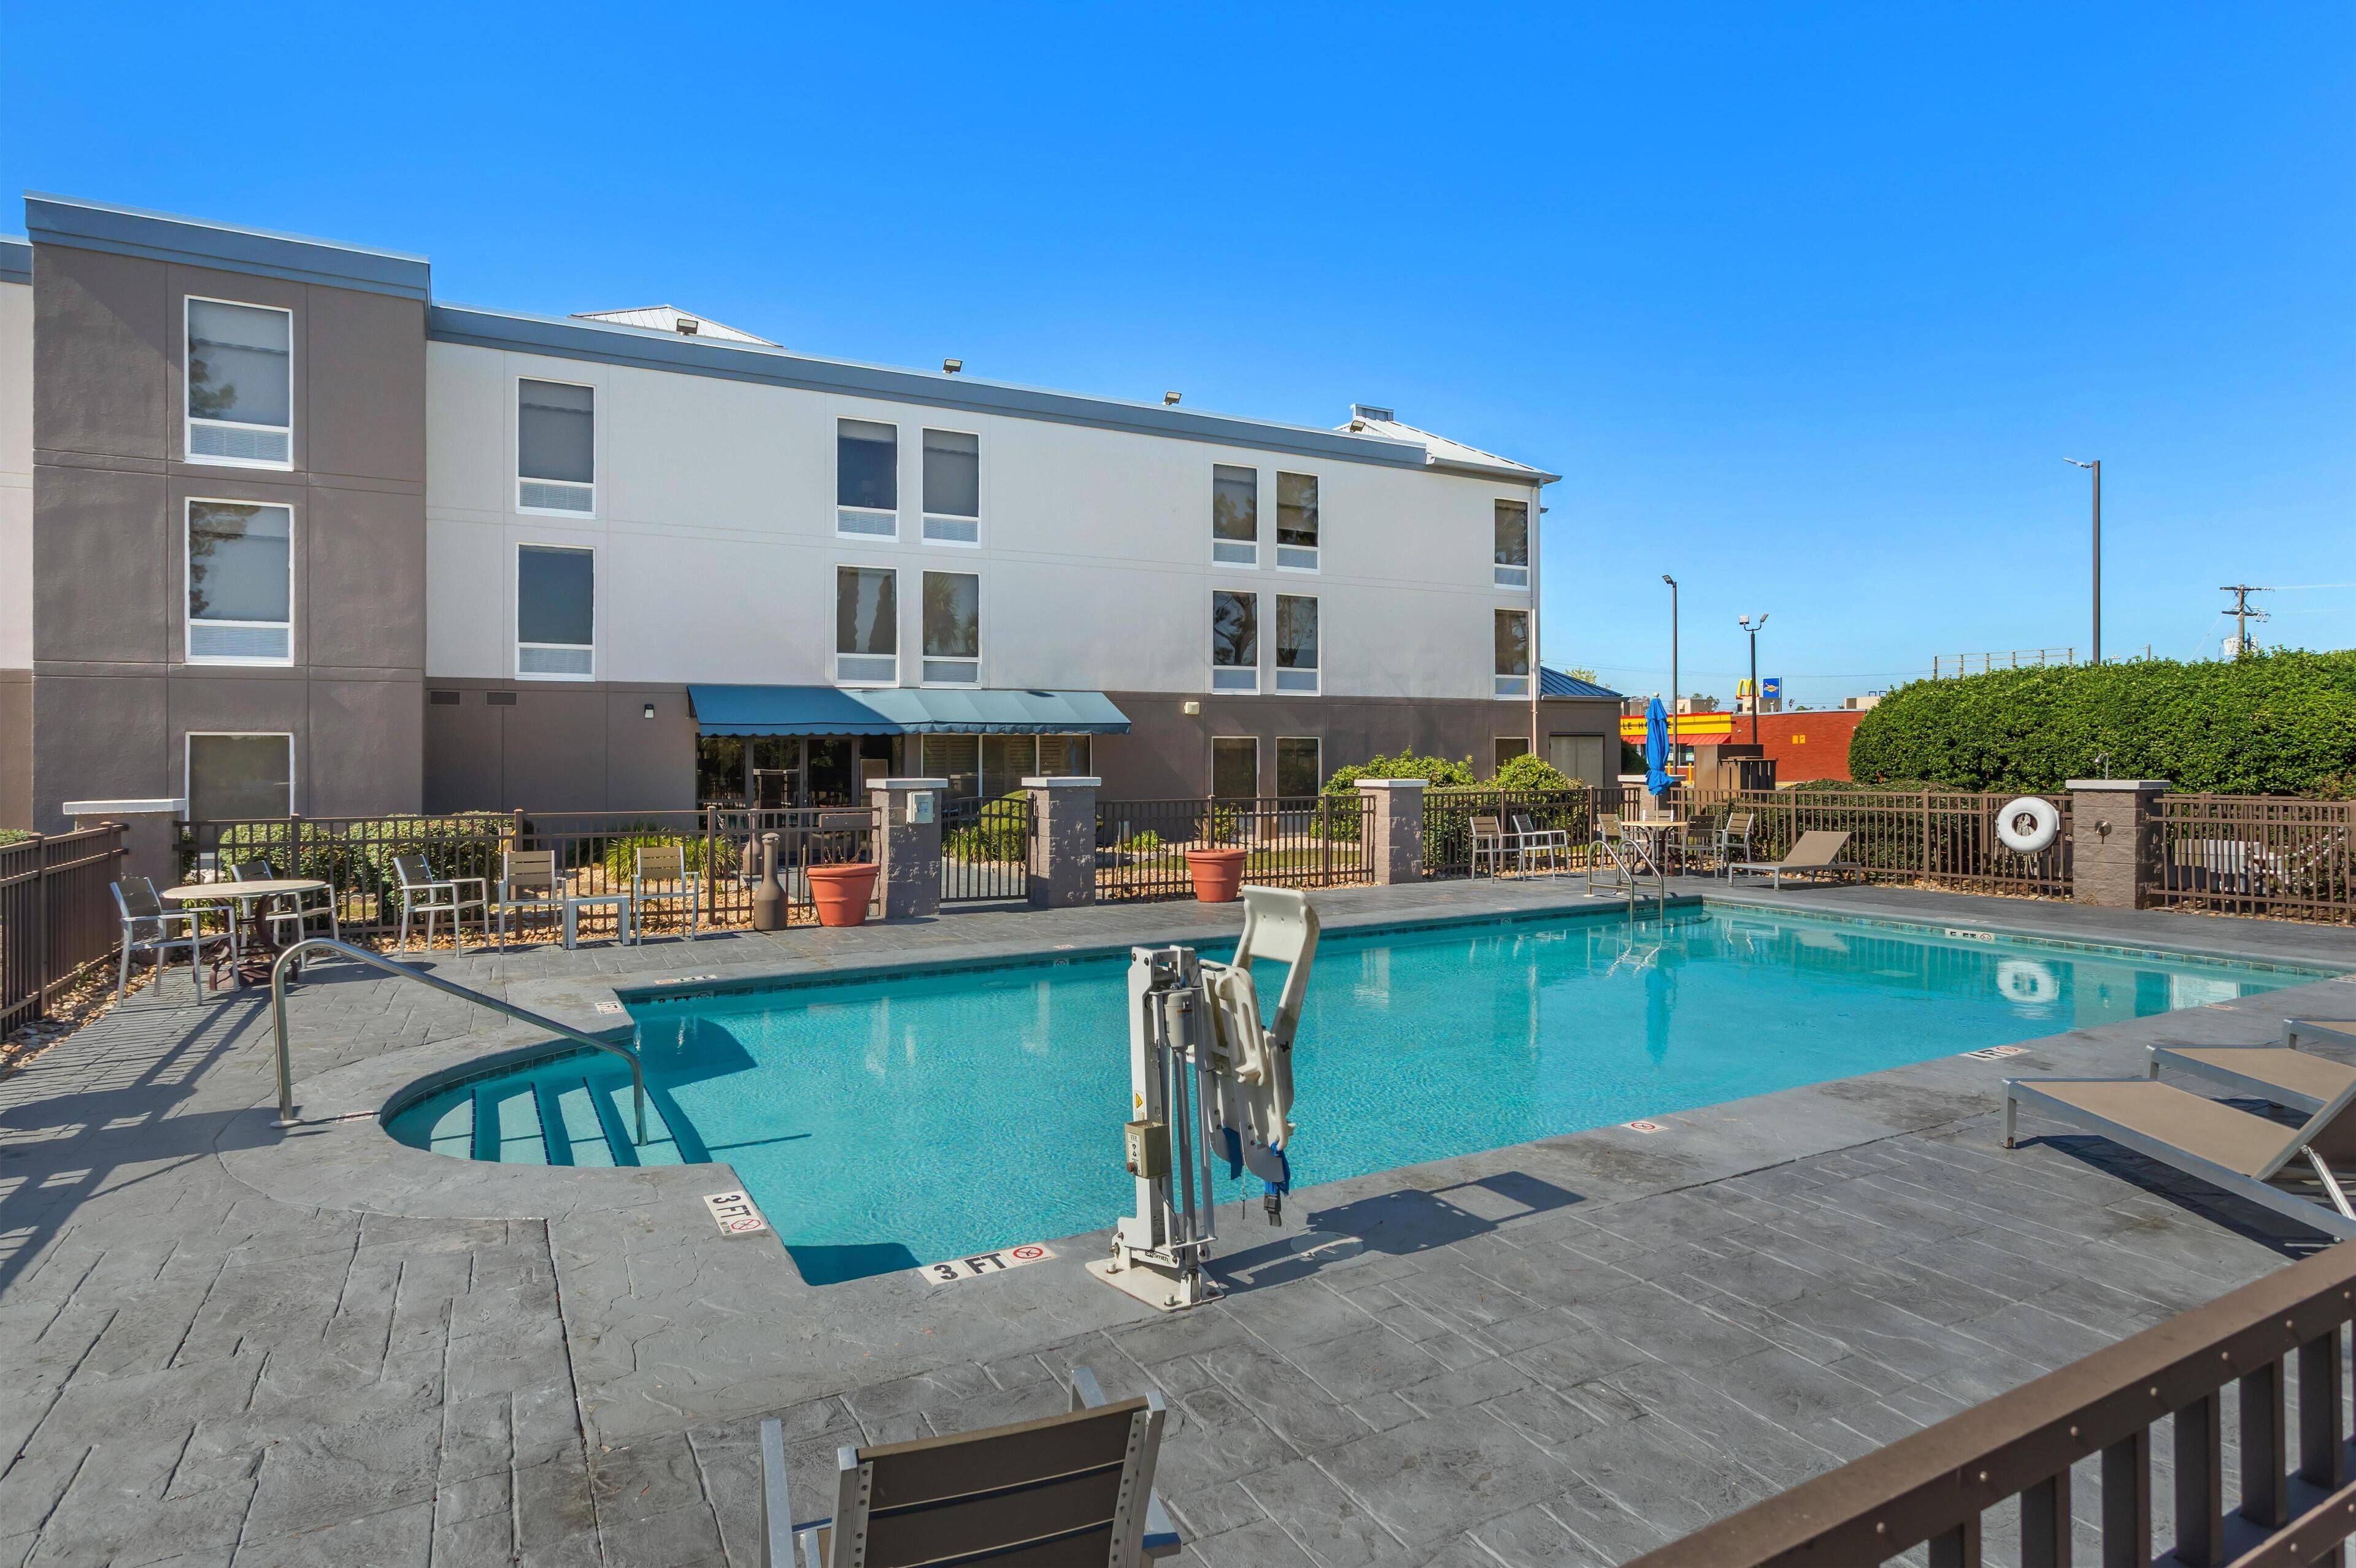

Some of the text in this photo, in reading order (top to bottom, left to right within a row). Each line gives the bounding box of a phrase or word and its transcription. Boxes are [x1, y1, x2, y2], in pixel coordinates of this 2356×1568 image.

[712, 1195, 752, 1218] 3 FT
[934, 1253, 1007, 1280] 3 FT
